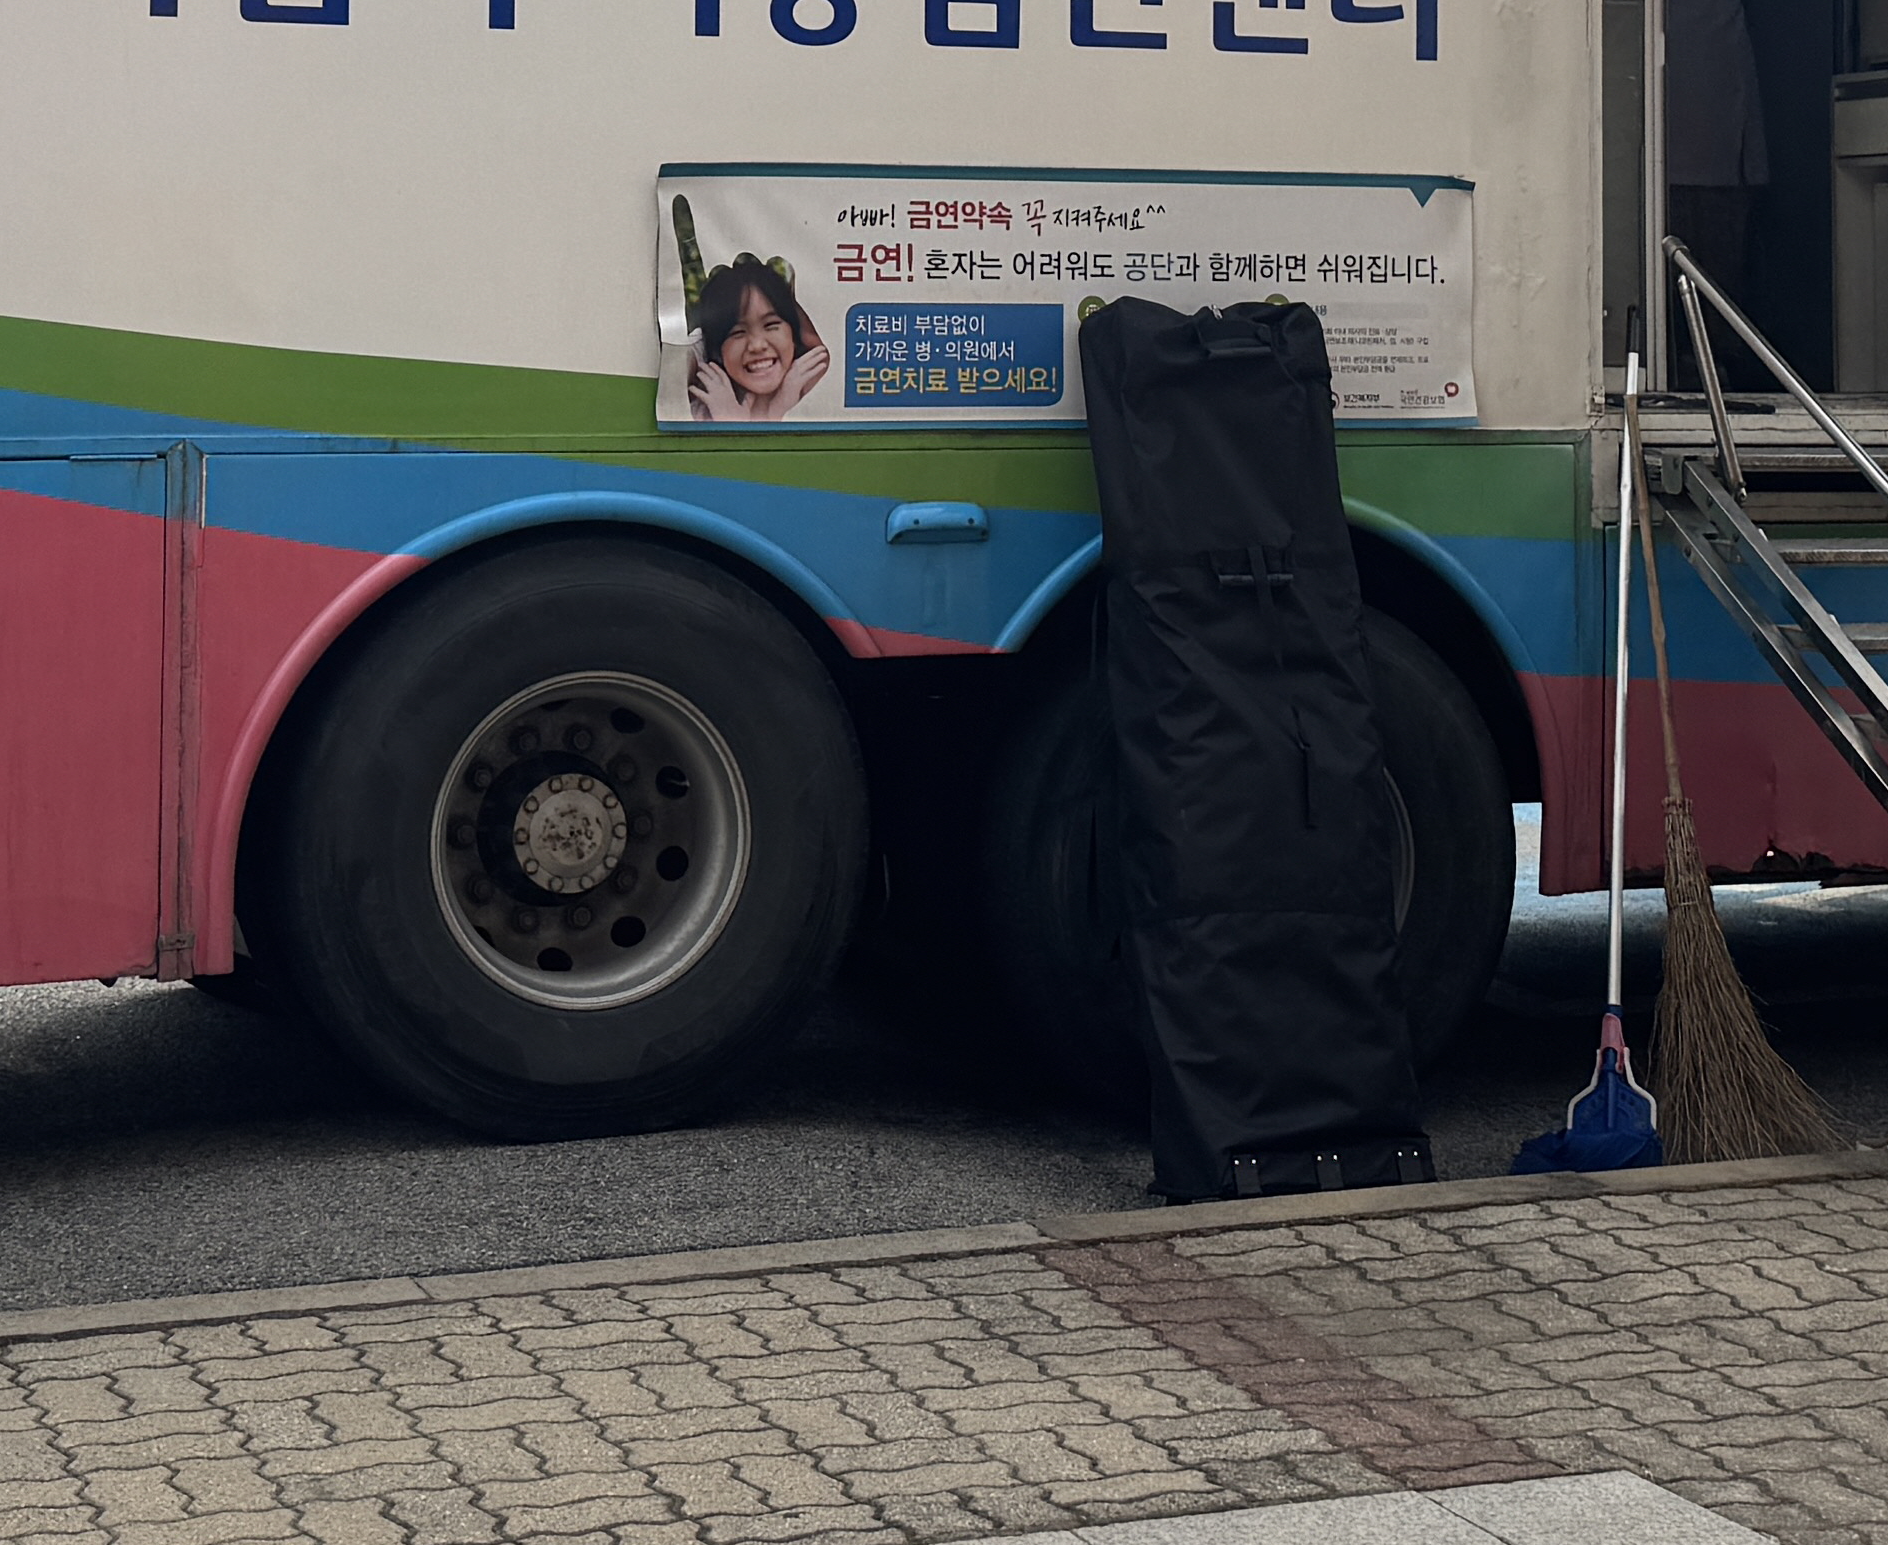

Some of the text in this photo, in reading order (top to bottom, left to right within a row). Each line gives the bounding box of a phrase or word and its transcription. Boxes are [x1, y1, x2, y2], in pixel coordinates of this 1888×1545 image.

[838, 204, 897, 229] 아빠!
[907, 200, 1013, 231] 금연약속
[1021, 198, 1047, 237] 꼭
[833, 242, 1446, 285] 금연! 혼자는 어려워도 공단과 함께하면 쉬워집니다.
[855, 315, 986, 336] 치료비 부담없이
[855, 340, 909, 362] 가까운
[854, 366, 1057, 394] 금연치료 받으세요!
